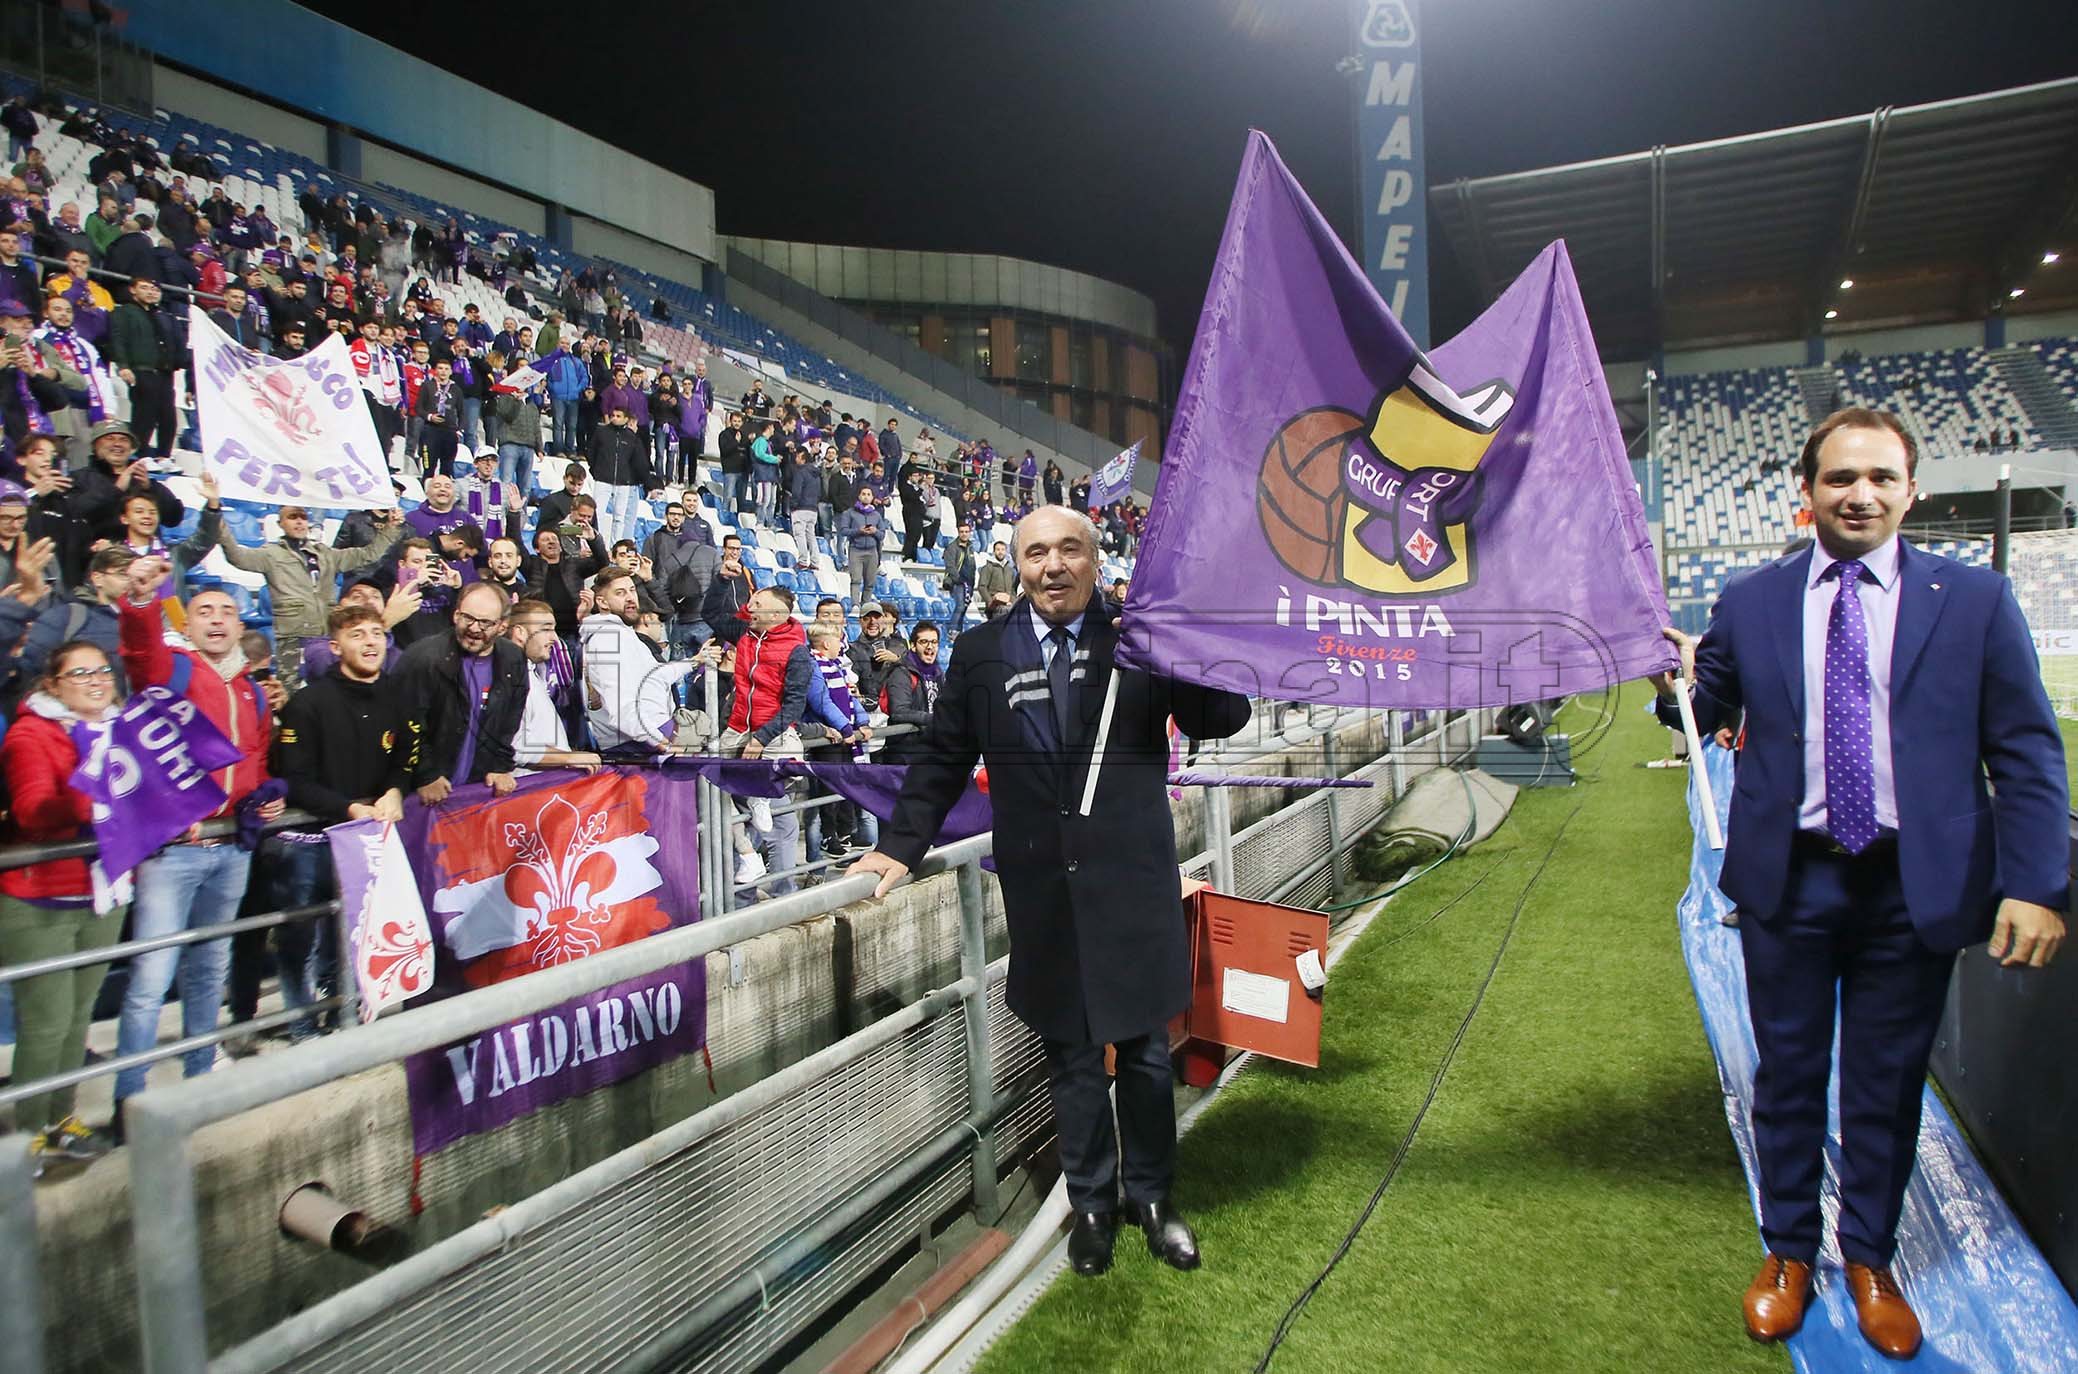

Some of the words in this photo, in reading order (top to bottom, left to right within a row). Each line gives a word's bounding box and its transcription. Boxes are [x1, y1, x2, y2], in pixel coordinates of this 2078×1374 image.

[1365, 60, 1416, 324] MAPEI
[213, 438, 302, 497] PER
[314, 442, 382, 500] TE!
[1305, 594, 1456, 638] PINTA
[1316, 635, 1418, 662] Firenze
[1326, 657, 1412, 681] 2015
[445, 981, 682, 1106] VALDARNO
